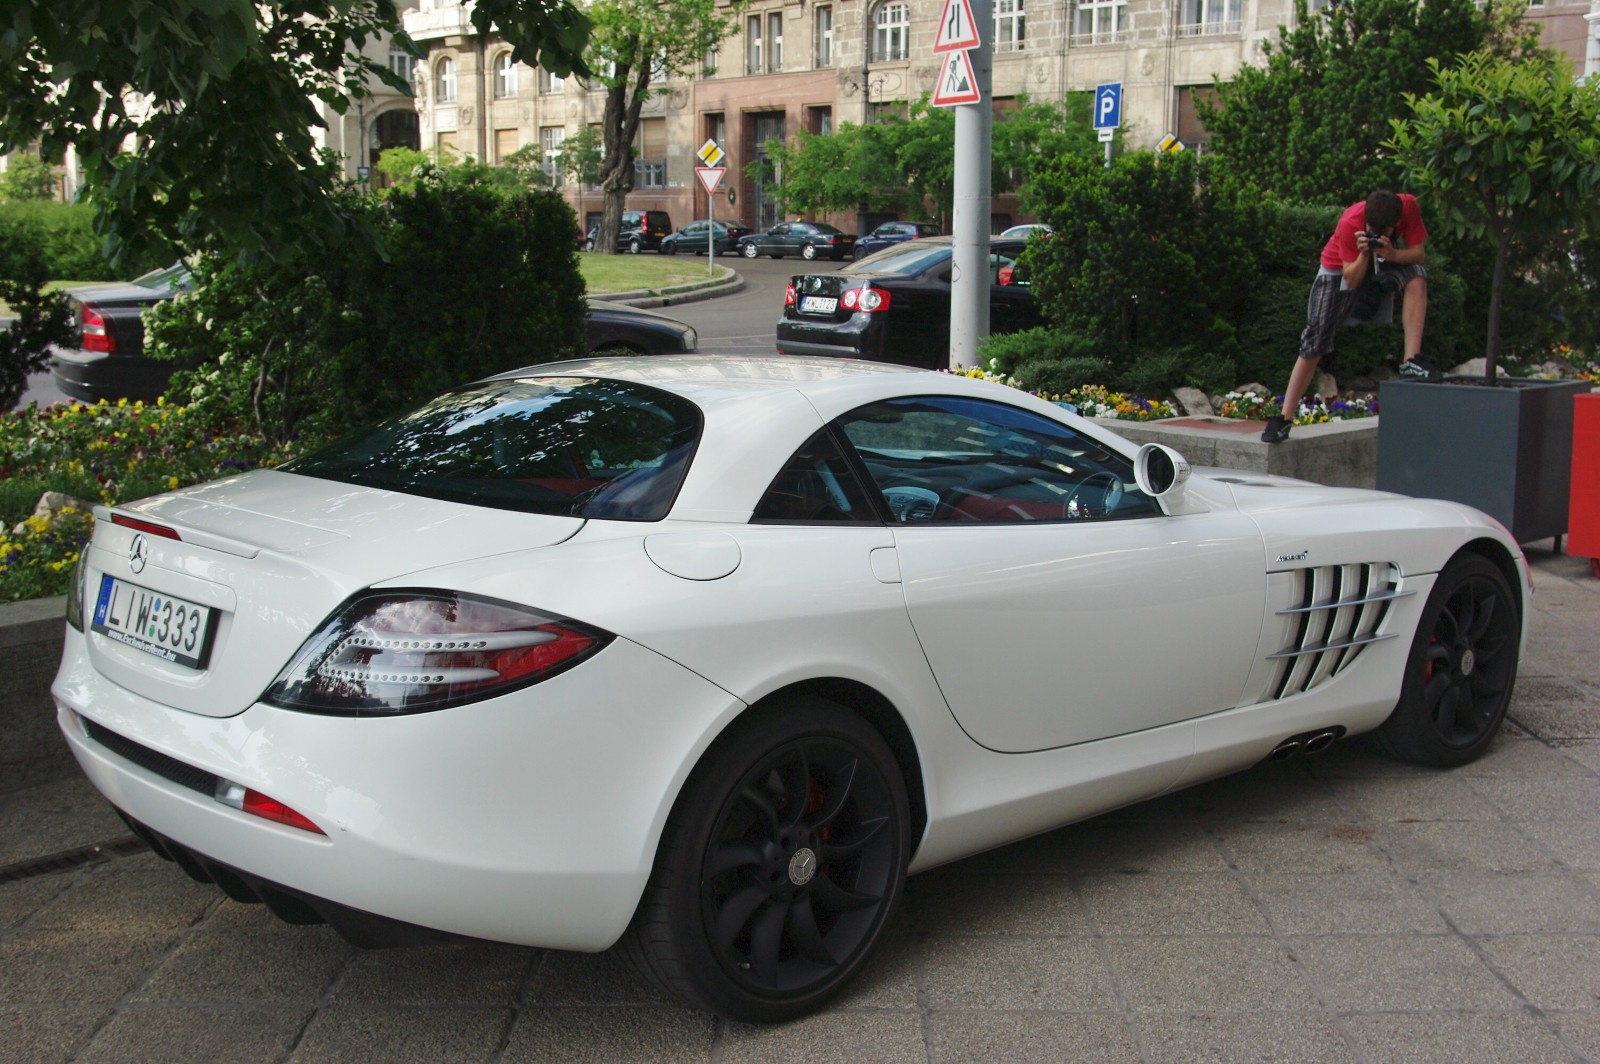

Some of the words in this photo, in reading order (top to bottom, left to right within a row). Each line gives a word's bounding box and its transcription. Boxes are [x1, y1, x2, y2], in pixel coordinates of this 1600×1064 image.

[1100, 96, 1115, 124] P
[98, 604, 107, 618] H
[107, 629, 177, 662] www.ExclusiveRent.hu
